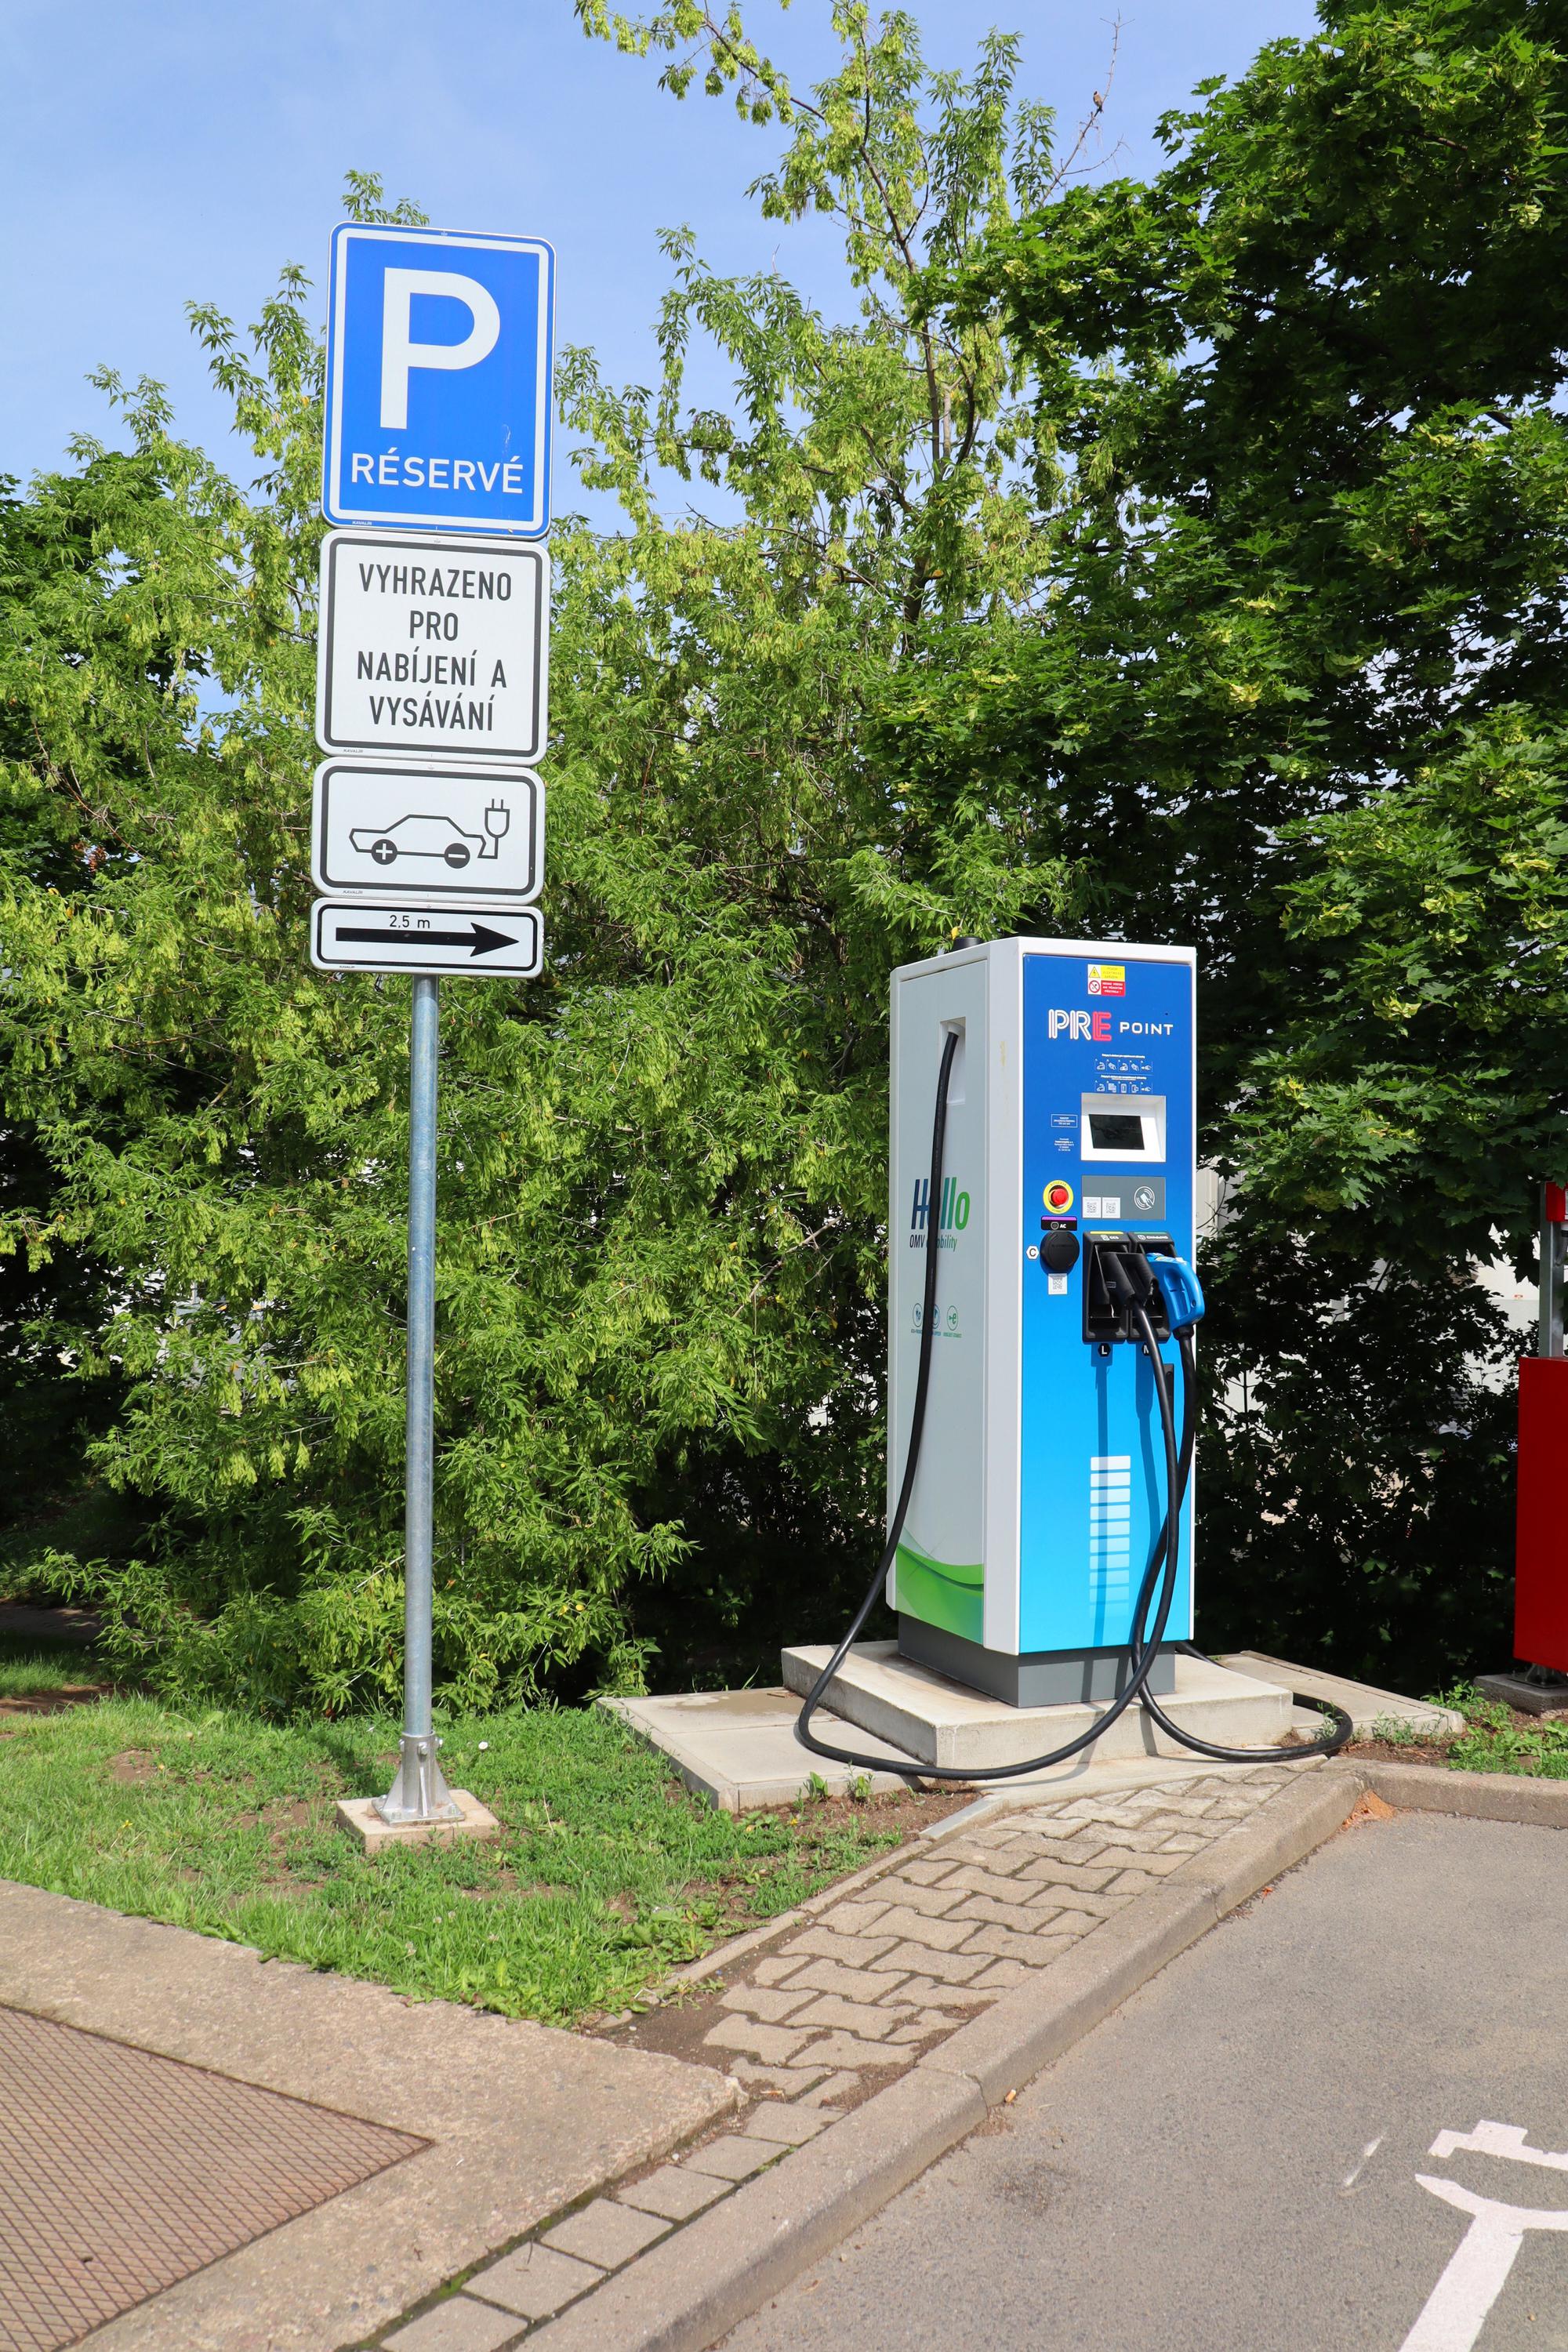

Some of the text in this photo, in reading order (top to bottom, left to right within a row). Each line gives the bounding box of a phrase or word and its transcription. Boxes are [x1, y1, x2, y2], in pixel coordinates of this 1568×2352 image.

[380, 267, 501, 430] P
[351, 447, 524, 494] RÉSERVÉ
[359, 563, 511, 601] VYHRAZENO
[409, 610, 459, 641] PRO
[358, 645, 507, 688] NABÍJENÍ A
[369, 691, 495, 731] VYSÁVÁNÍ
[417, 919, 430, 929] m
[1048, 1009, 1174, 1042] PRE POINT
[911, 1177, 971, 1230] Hllo
[909, 1234, 926, 1248] OMV
[1029, 1247, 1037, 1257] C
[1102, 1345, 1108, 1355] L
